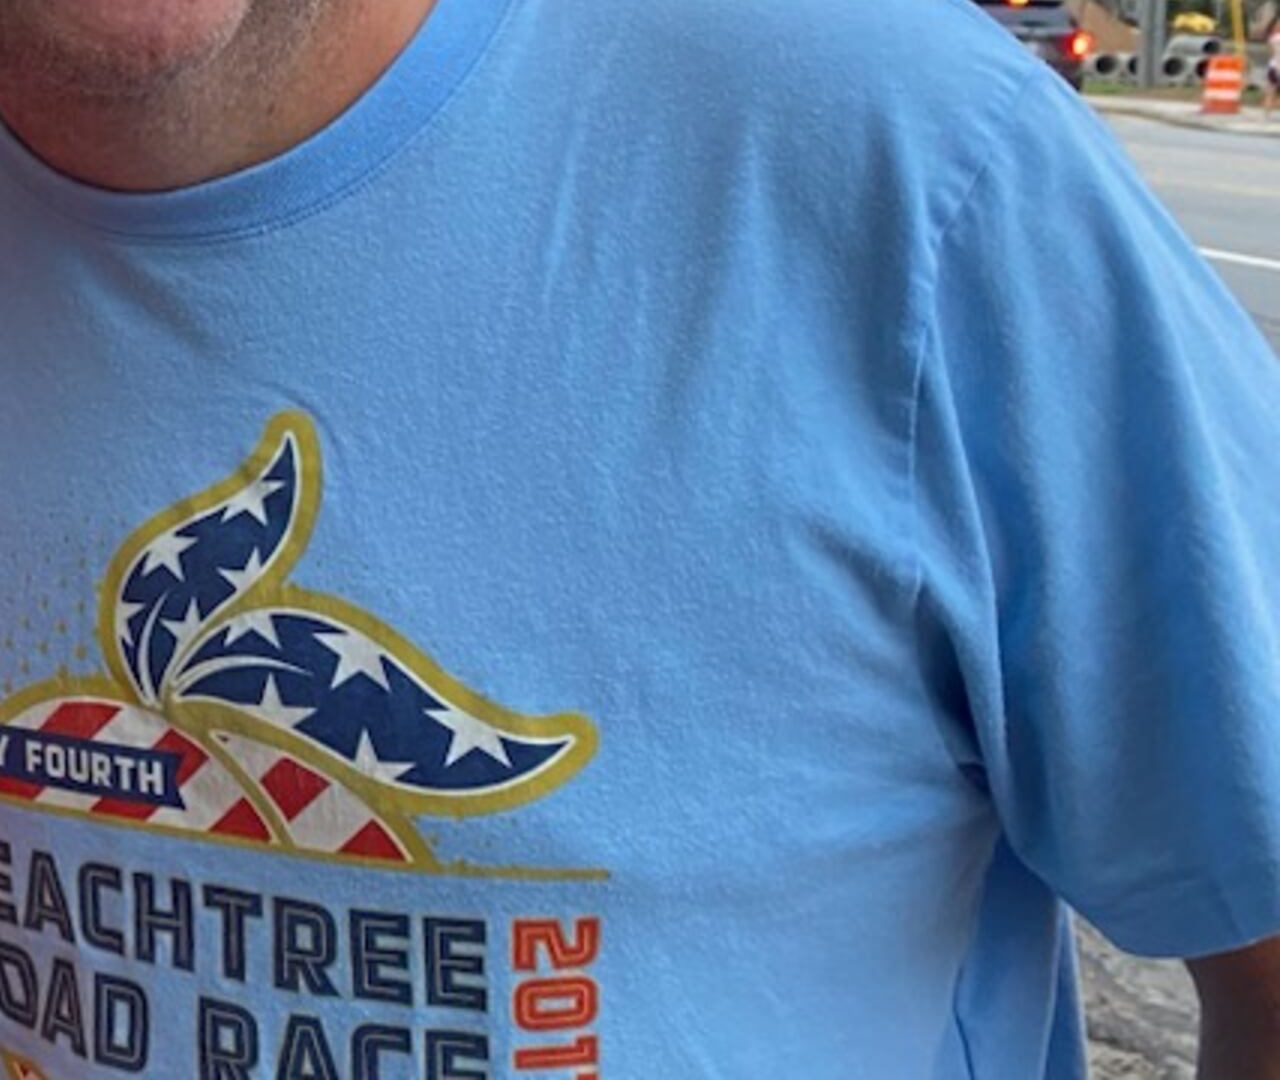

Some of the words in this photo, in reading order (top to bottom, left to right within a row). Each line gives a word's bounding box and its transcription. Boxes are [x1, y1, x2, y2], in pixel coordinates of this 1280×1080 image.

[25, 740, 165, 796] FOURTH
[198, 996, 491, 1080] RACE
[512, 917, 601, 1080] 201
